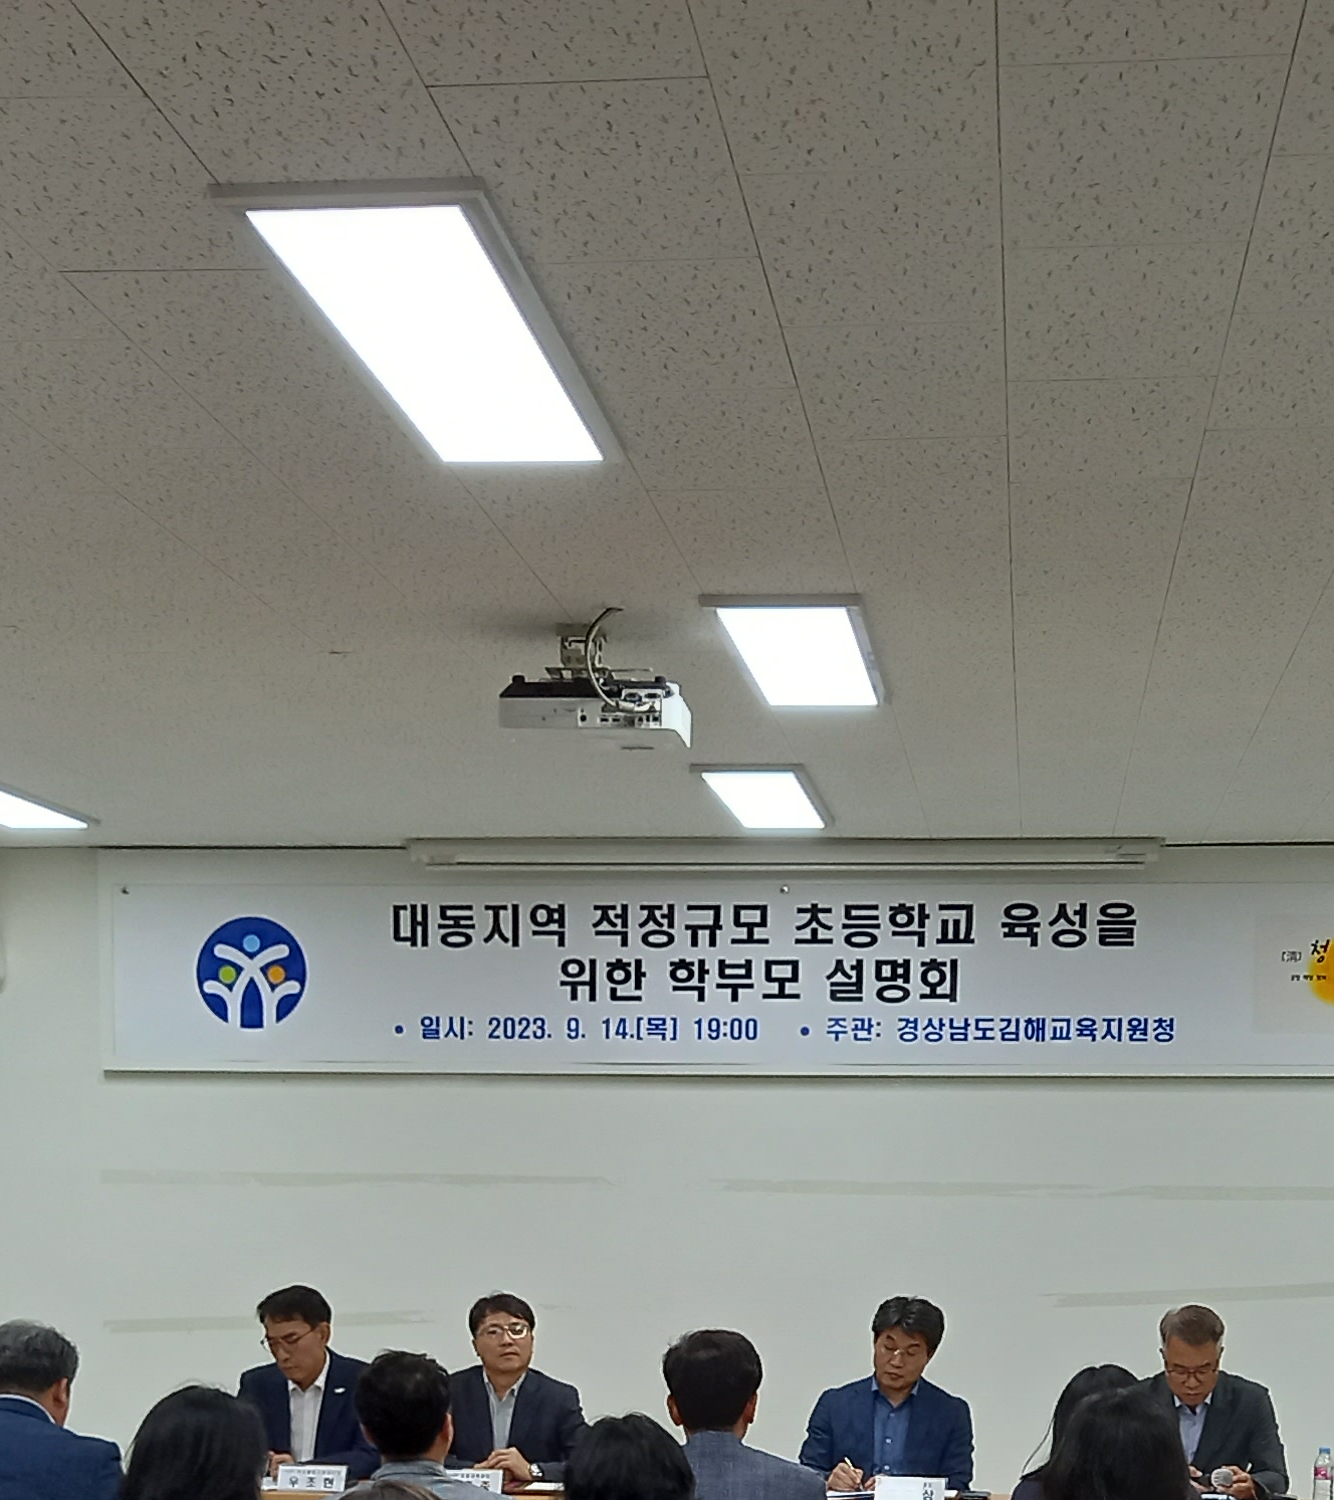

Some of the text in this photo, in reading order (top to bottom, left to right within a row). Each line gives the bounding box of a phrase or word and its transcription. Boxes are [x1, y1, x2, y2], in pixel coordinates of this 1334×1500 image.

[392, 902, 1137, 949] 대동지역 적정규모 초등학교 육성을
[1311, 939, 1330, 963] 청
[559, 957, 959, 1004] 위한 학부모 설명회
[420, 1015, 474, 1041] 일시:
[487, 1016, 552, 1040] 2023.
[566, 1017, 586, 1041] 9.
[693, 1017, 758, 1041] 19:00
[826, 1016, 1175, 1043] 주관: 경상남도김해교육지원청
